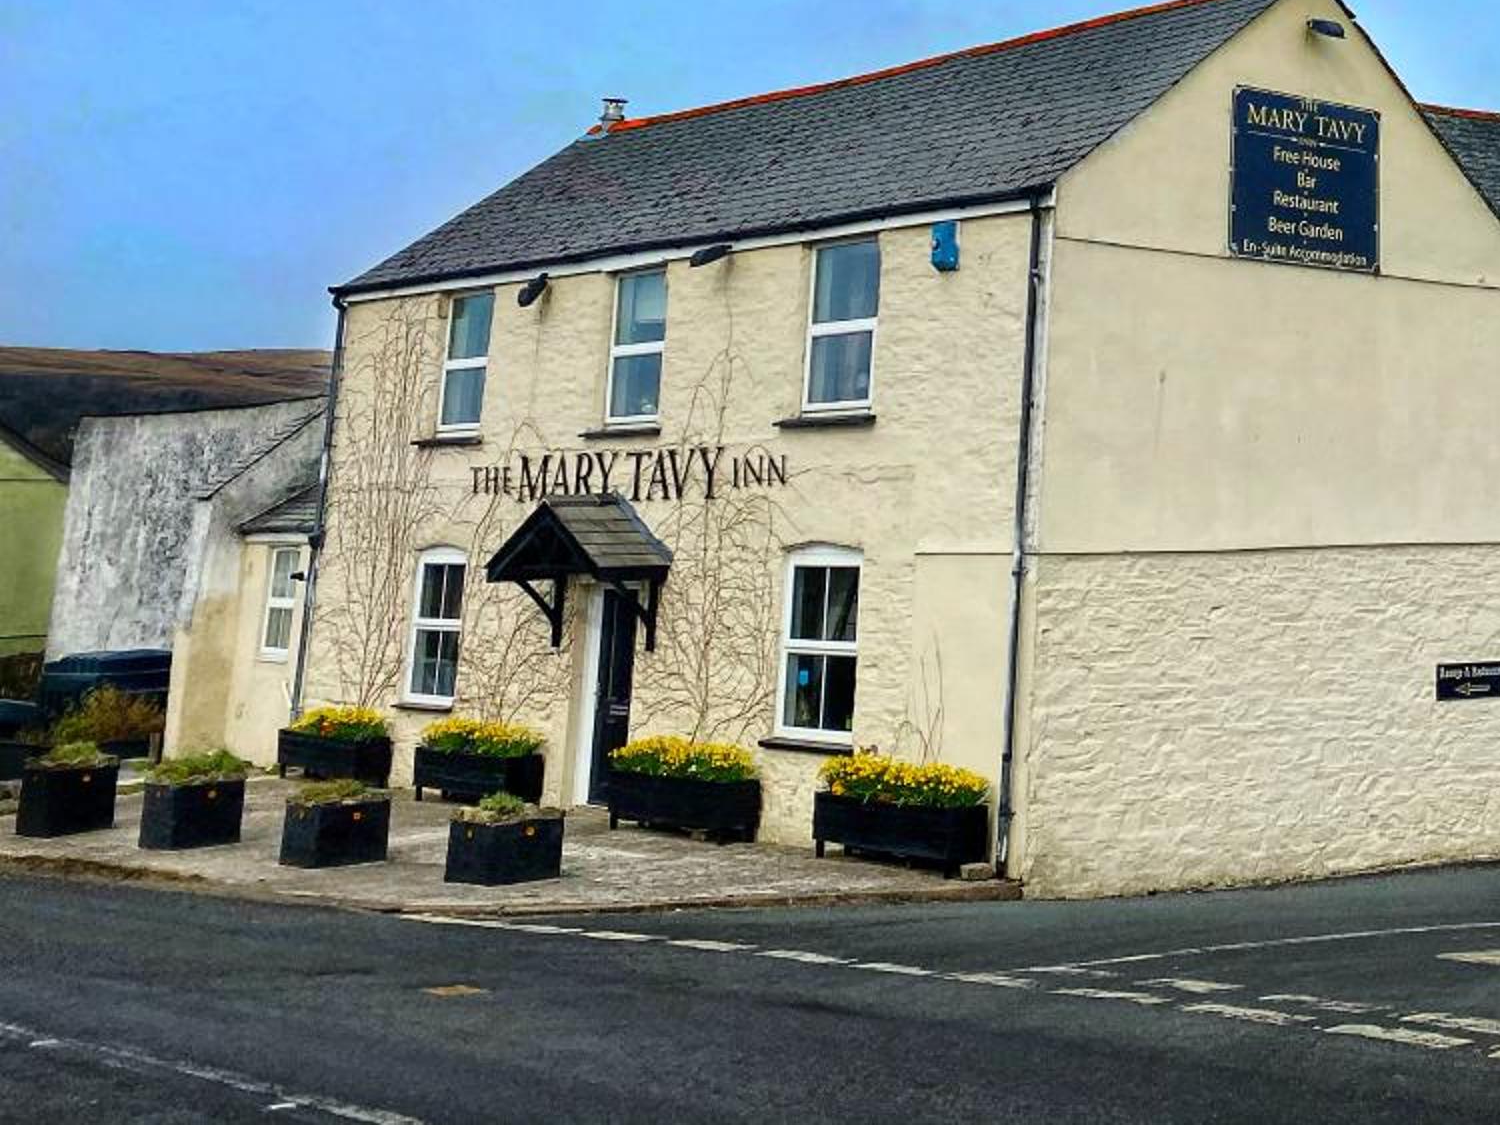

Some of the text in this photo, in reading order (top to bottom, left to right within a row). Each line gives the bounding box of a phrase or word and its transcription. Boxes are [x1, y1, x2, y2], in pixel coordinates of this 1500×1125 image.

[1299, 100, 1318, 113] THE
[1247, 102, 1367, 143] MARY TAVY
[1273, 146, 1341, 171] Free House
[1297, 172, 1316, 188] Bar
[1273, 190, 1339, 213] Restaurant
[1268, 216, 1343, 241] Beer Garden
[469, 446, 787, 503] THE MARY TAVY INN
